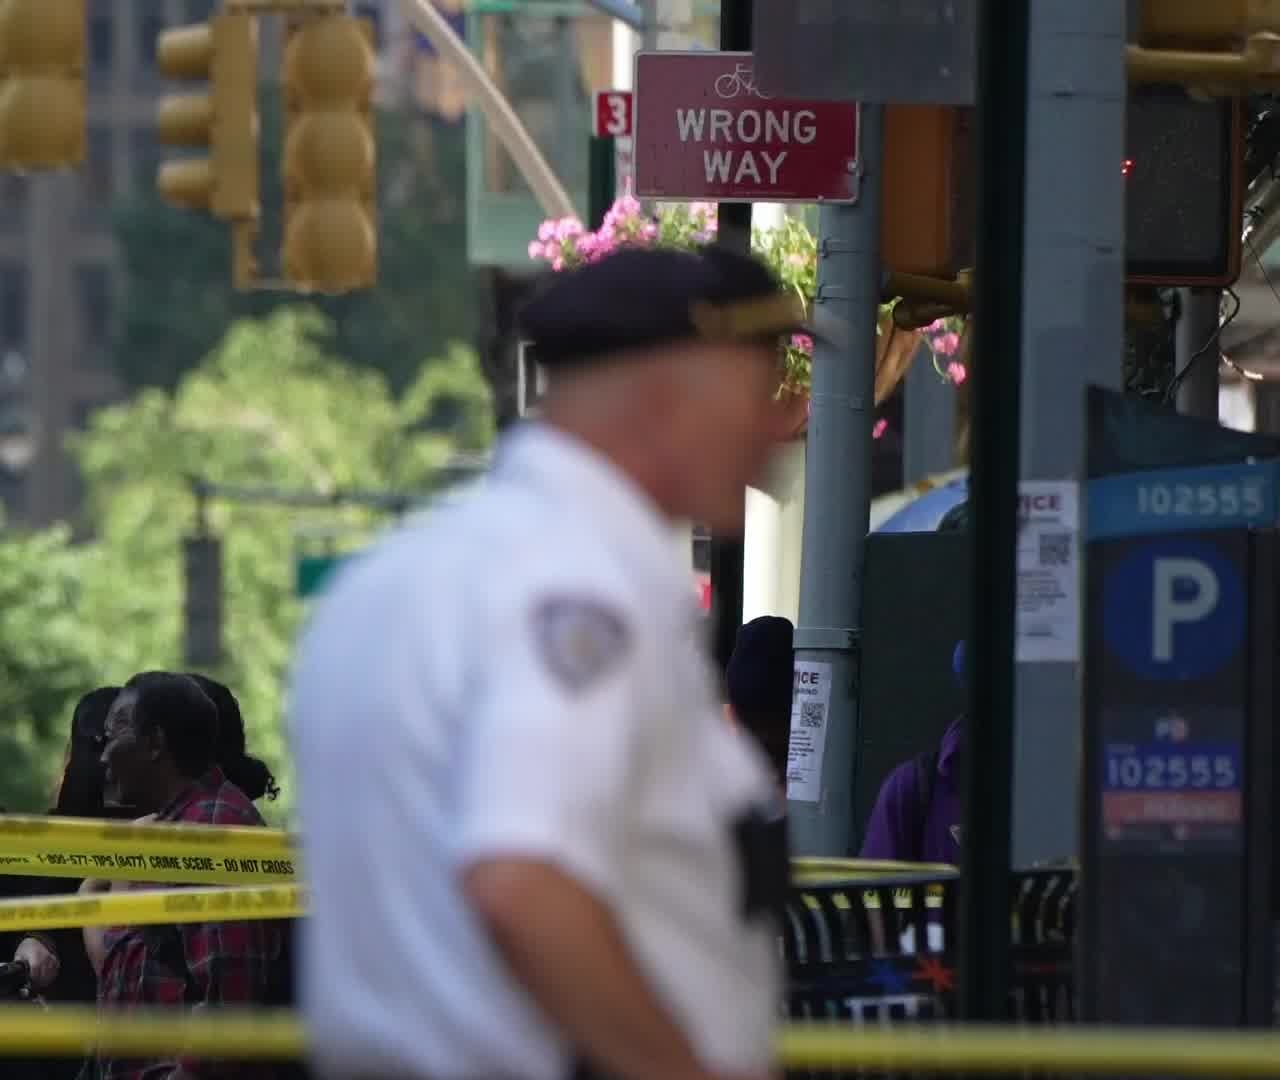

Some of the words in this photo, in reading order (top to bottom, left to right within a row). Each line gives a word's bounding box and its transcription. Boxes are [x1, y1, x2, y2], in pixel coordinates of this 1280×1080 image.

[676, 108, 816, 144] WRONG
[703, 150, 788, 184] WAY
[1137, 480, 1264, 516] 102555
[1152, 557, 1219, 661] P
[1108, 755, 1236, 788] 102555
[149, 856, 181, 870] CRIME
[182, 857, 216, 872] SCENE
[224, 859, 238, 873] DO
[241, 860, 260, 874] NOT
[261, 860, 295, 875] CROSS
